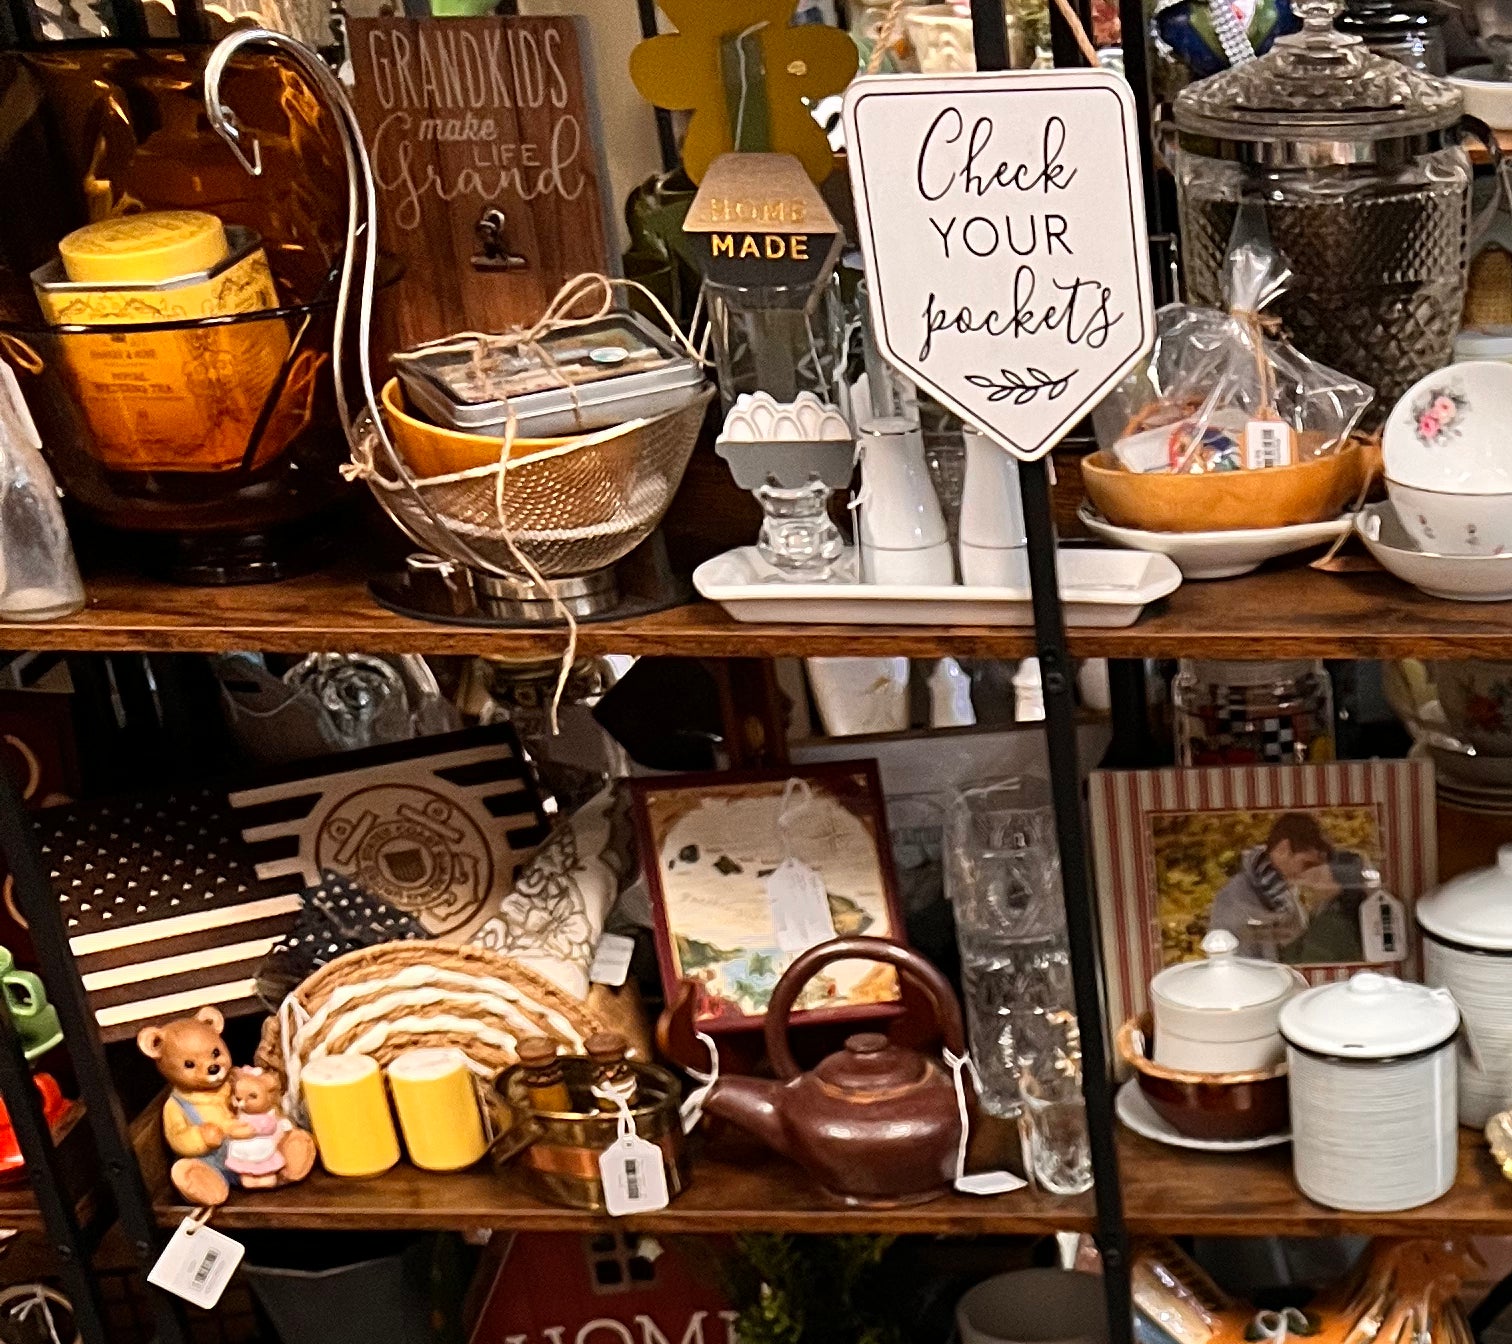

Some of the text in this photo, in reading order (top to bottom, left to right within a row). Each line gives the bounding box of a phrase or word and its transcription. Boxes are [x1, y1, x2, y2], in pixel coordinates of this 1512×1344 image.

[369, 28, 568, 109] GRANDKIDS
[418, 112, 498, 142] make
[371, 112, 585, 230] Grand
[474, 144, 541, 167] LIFE
[918, 107, 1077, 201] Check
[710, 197, 809, 223] HOME
[711, 234, 809, 260] MADE
[929, 214, 1075, 258] YOUR
[918, 265, 1125, 362] pockets
